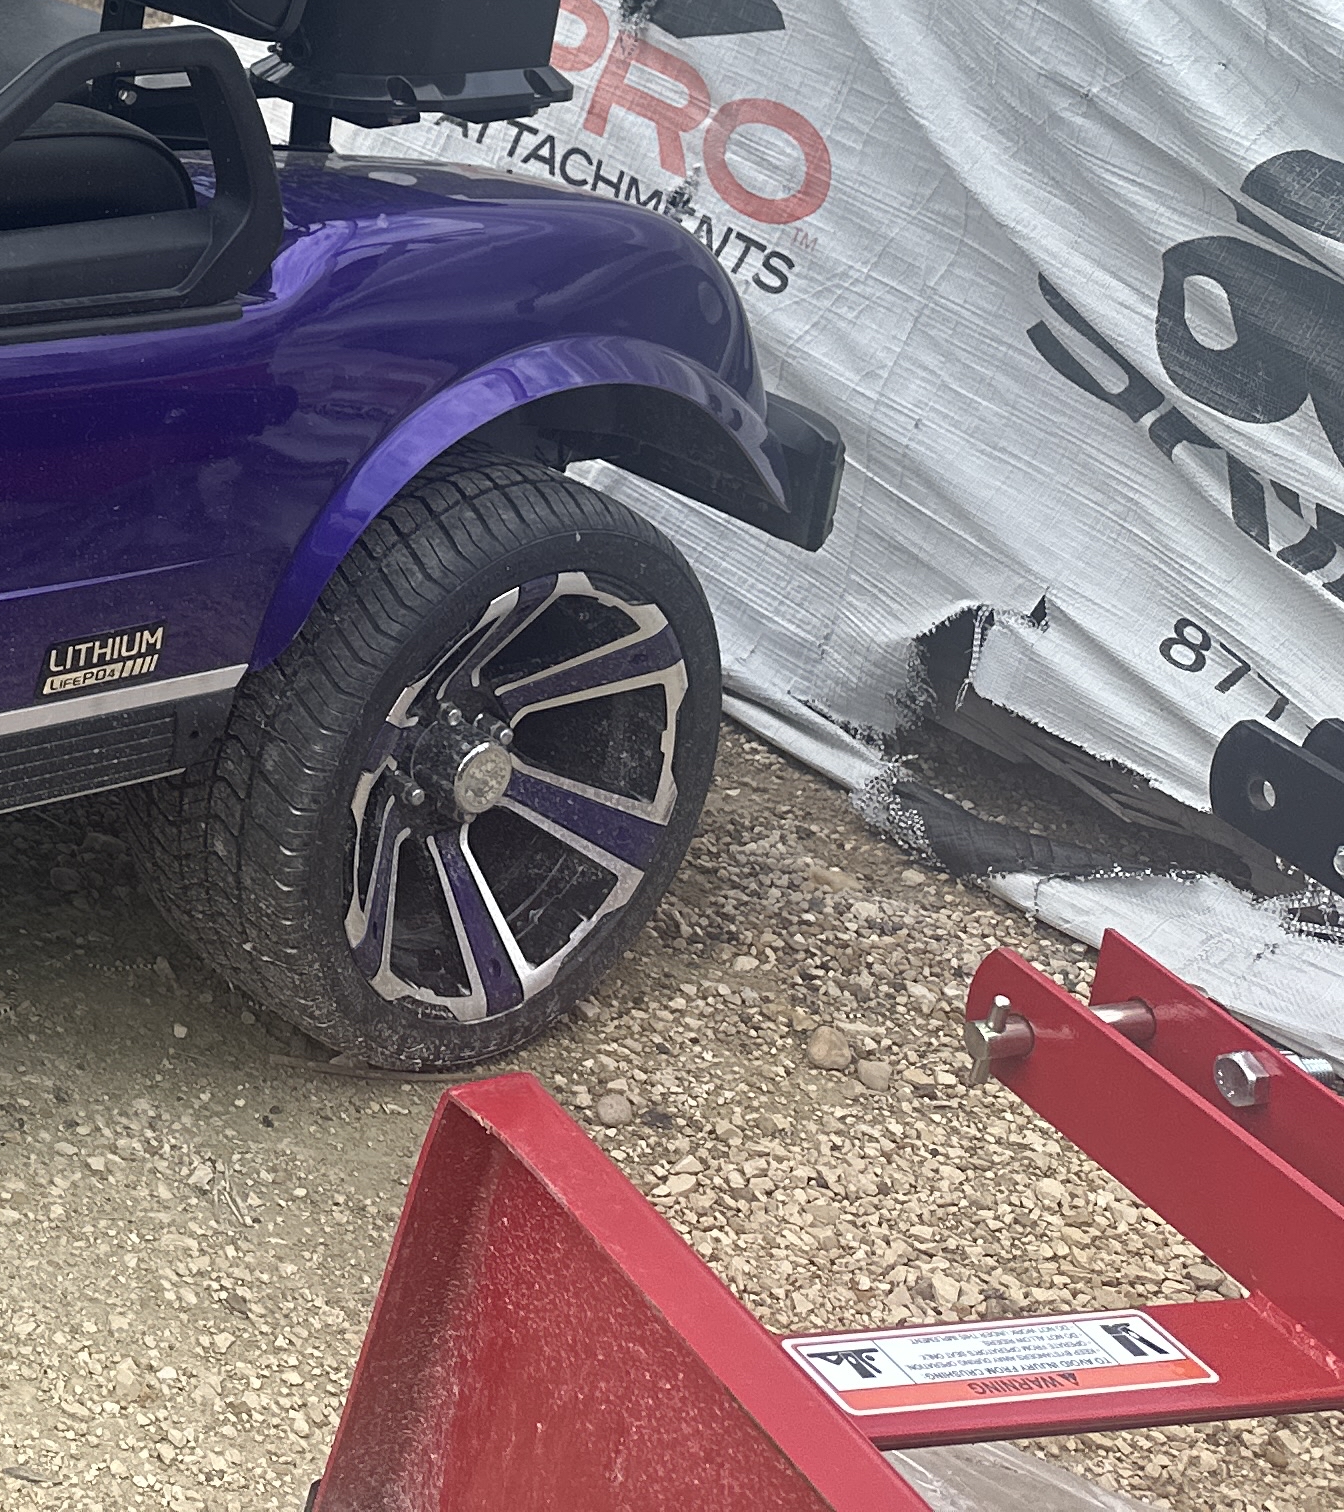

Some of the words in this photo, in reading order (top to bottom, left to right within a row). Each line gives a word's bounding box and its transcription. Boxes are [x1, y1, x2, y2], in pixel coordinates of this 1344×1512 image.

[49, 626, 164, 672] LITHIUM
[1059, 1357, 1094, 1368] AVOID
[1094, 1356, 1113, 1365] TO
[984, 1365, 1020, 1373] FROM
[1020, 1361, 1059, 1372] INJURY
[967, 1374, 1065, 1395] WARNING
